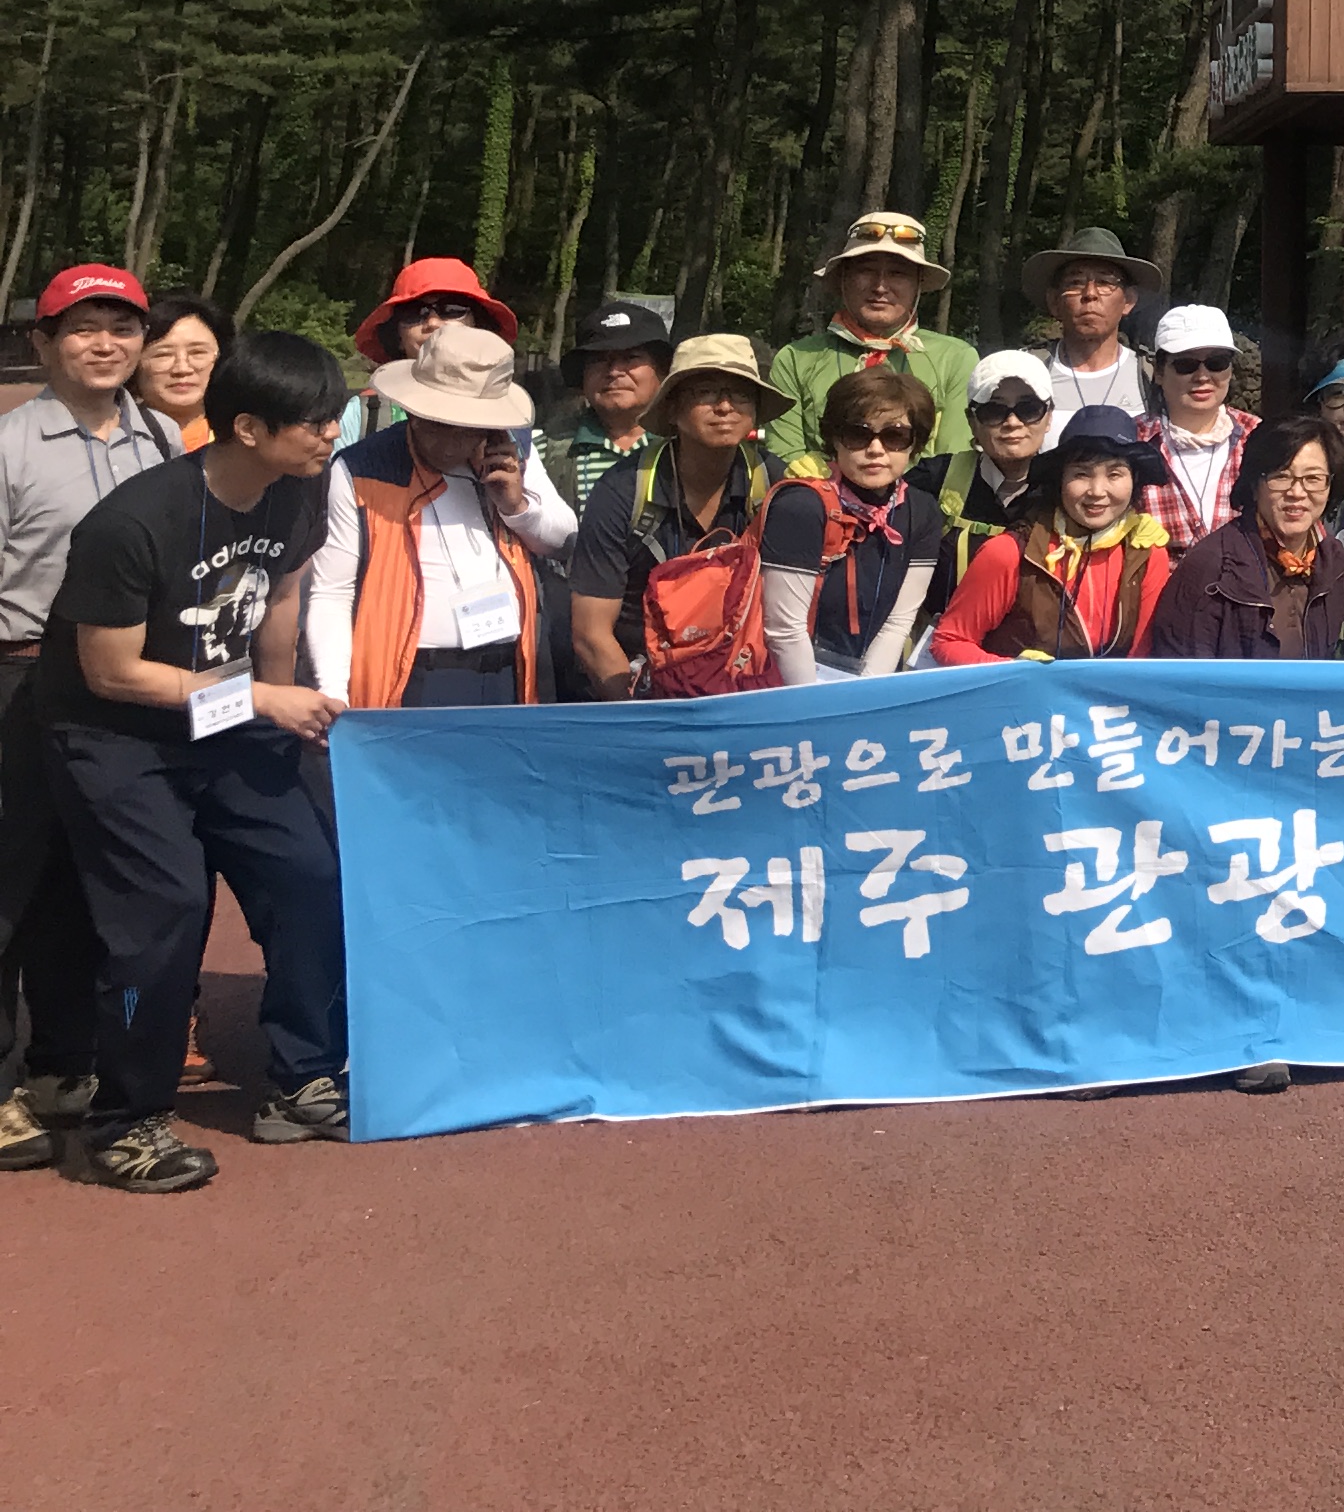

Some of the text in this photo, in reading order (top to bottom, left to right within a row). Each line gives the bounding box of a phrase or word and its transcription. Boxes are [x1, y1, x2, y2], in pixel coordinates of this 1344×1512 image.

[191, 534, 285, 580] adidas
[663, 727, 973, 816] 관광으로
[681, 829, 970, 959] 제주
